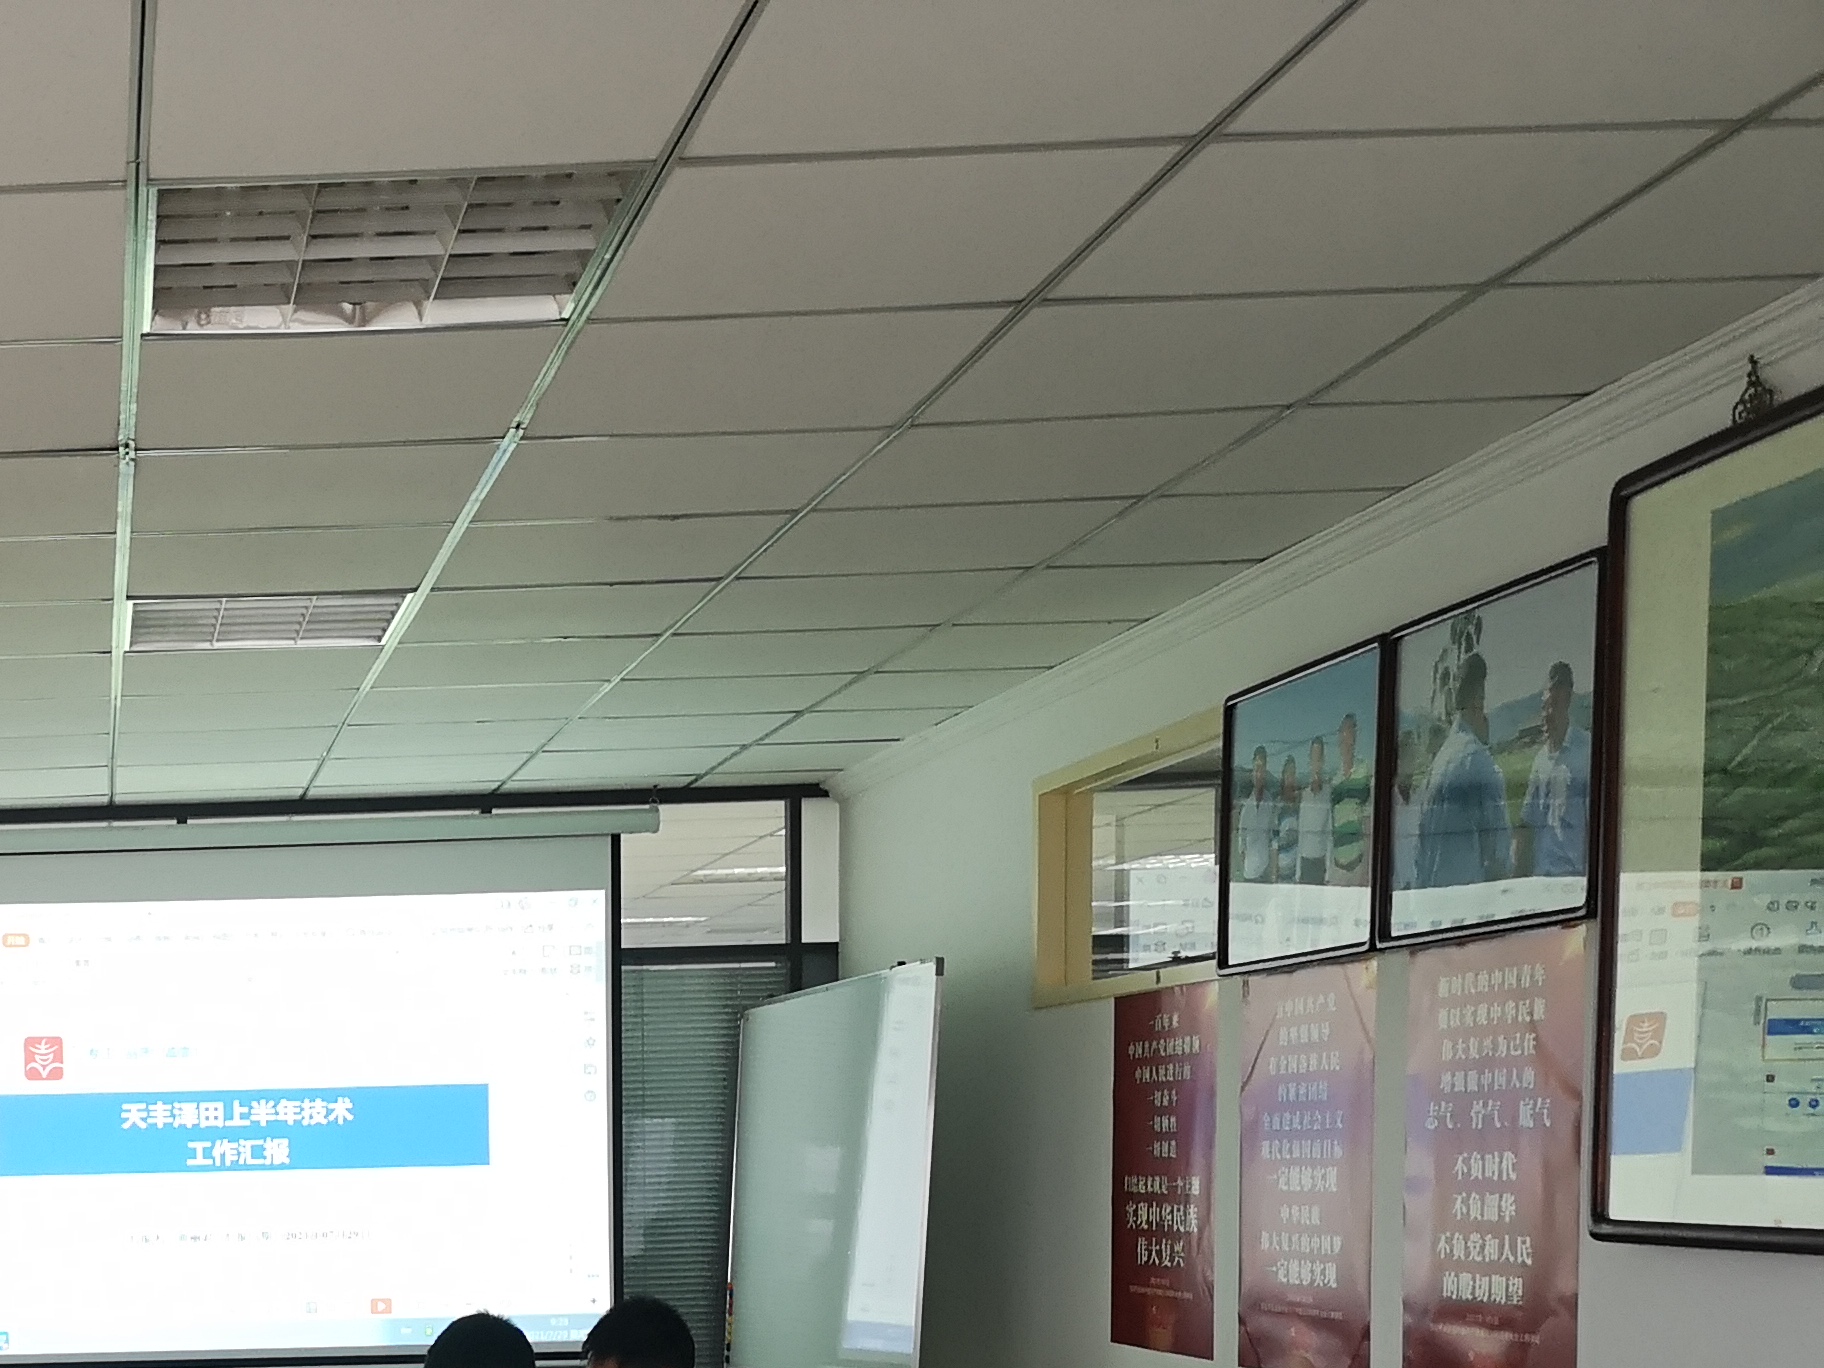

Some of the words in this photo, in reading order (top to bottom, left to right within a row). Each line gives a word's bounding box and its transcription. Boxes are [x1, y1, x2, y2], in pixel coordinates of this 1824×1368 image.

[1438, 963, 1546, 998] 新时代的中国青年
[1441, 1032, 1536, 1061] 伟大复兴为己任
[120, 1096, 355, 1130] 天丰泽田上半年技术
[186, 1138, 290, 1167] 工作汇报
[1453, 1151, 1517, 1181] 不负时代
[1266, 1165, 1338, 1192] 一定能够实现
[1126, 1200, 1198, 1233] 实现中华民族
[1452, 1192, 1516, 1223] 不负韶华
[1137, 1237, 1185, 1267] 伟大复兴
[1437, 1232, 1532, 1266] 不负党和人民
[1265, 1258, 1338, 1288] 一定能够实现
[1442, 1271, 1524, 1305] 的殷切期望
[526, 1329, 569, 1340] 021/7/29
